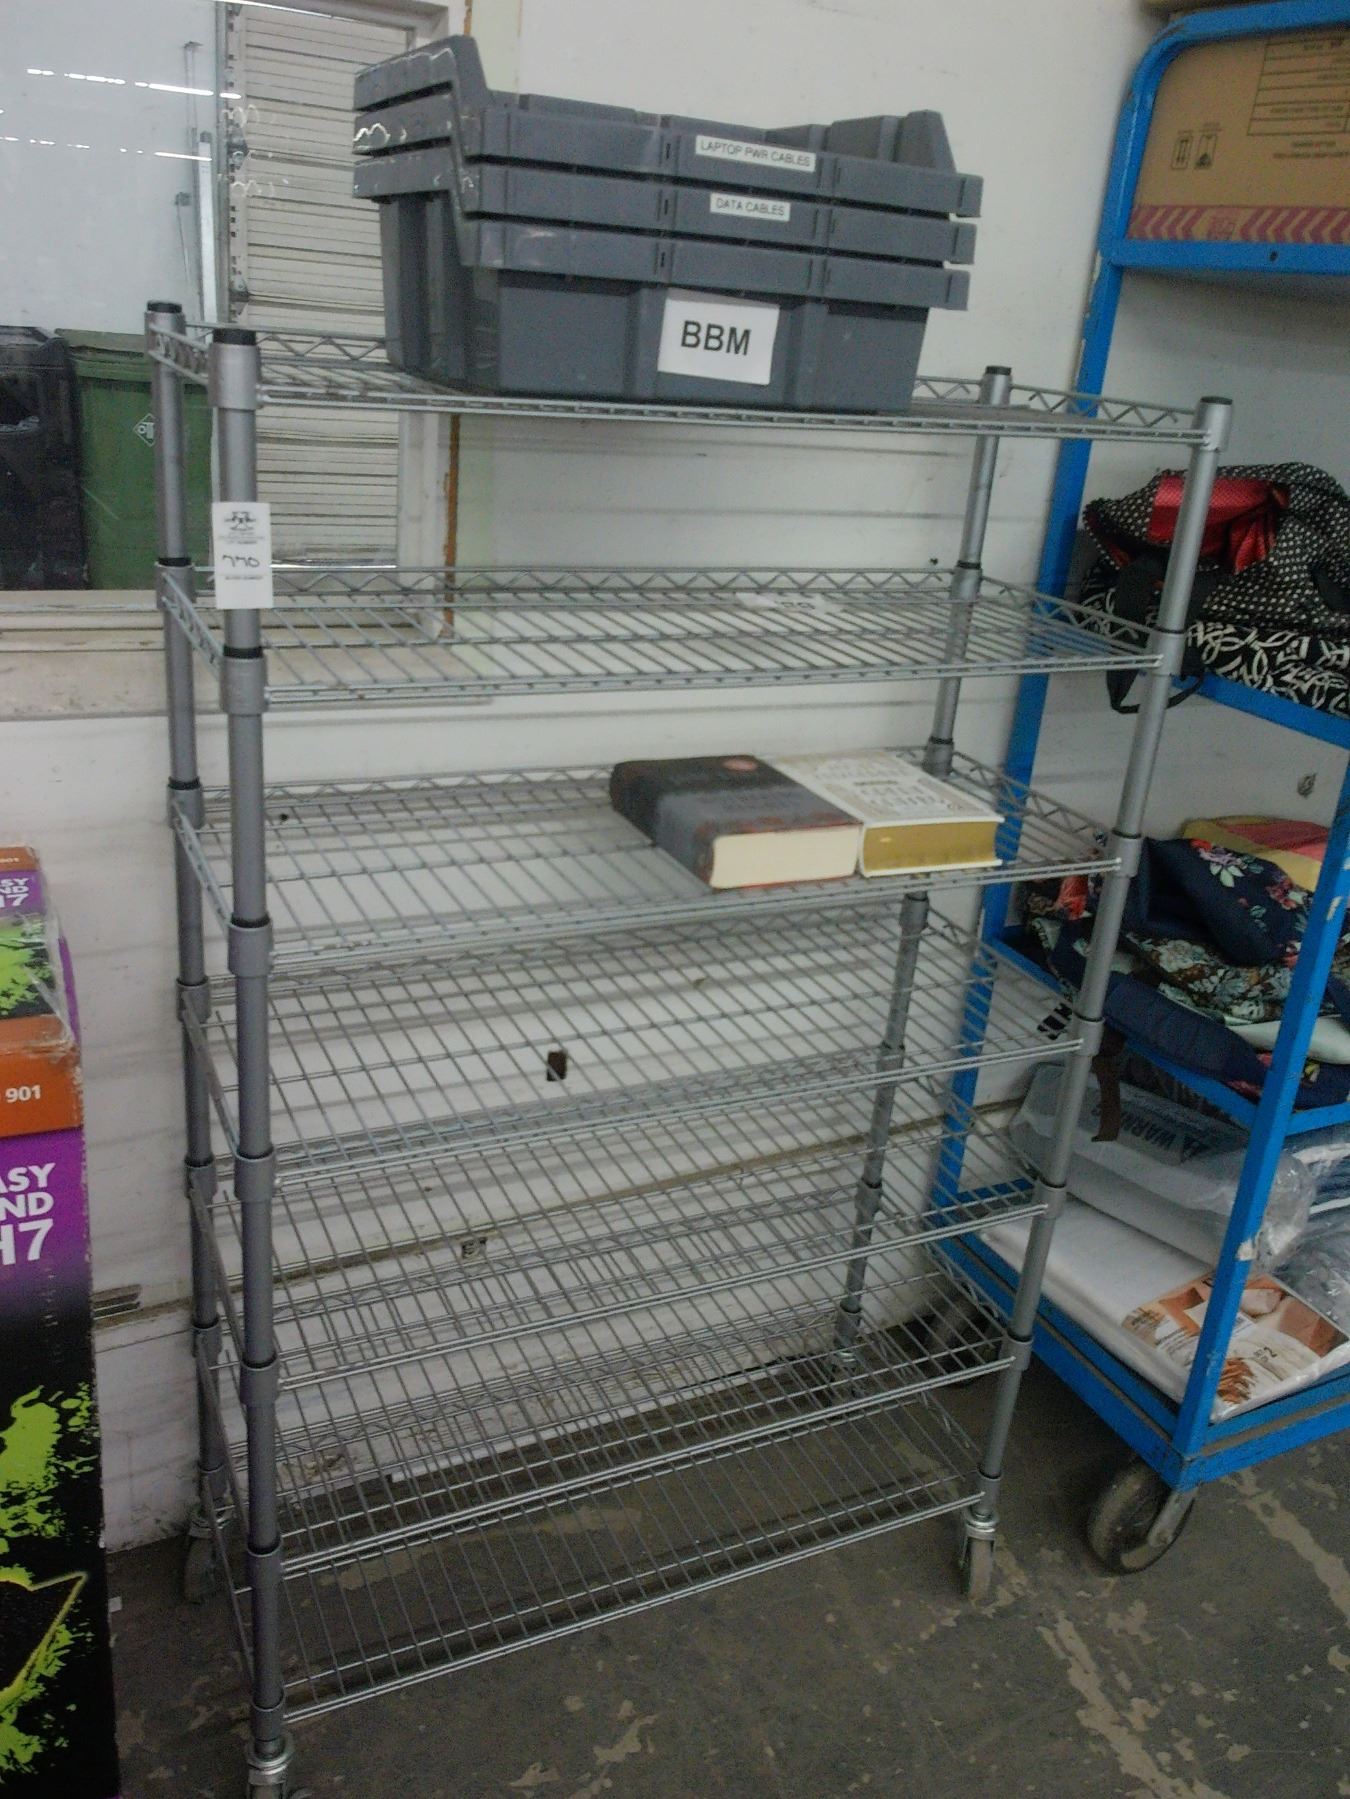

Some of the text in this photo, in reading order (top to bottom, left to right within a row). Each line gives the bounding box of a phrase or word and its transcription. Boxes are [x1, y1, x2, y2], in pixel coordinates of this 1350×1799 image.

[701, 140, 811, 167] LAPTOP PWR CABLES
[716, 197, 785, 216] DATA CABLES
[681, 320, 751, 356] BBM
[5, 1084, 41, 1104] 901
